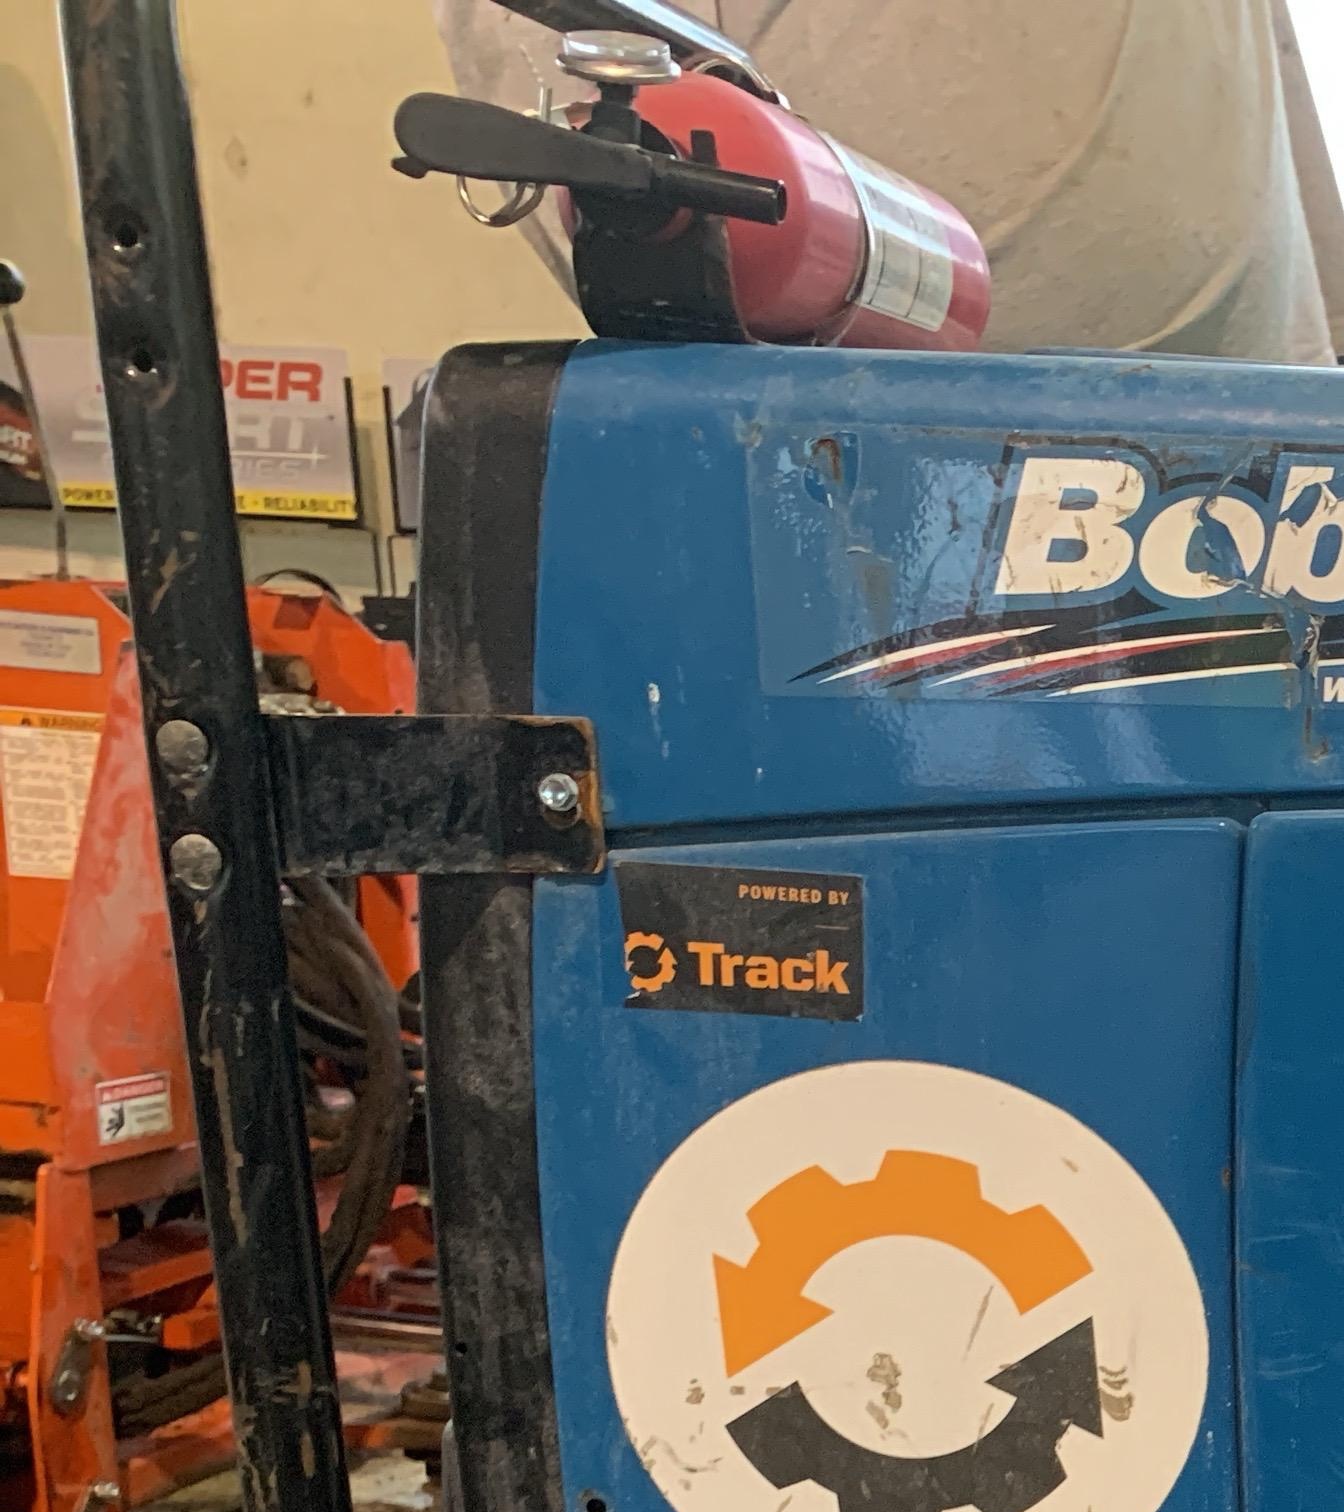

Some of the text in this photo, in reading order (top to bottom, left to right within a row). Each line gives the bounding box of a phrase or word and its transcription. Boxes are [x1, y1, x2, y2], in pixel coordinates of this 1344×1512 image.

[738, 884, 849, 906] POWERED BY
[687, 941, 850, 995] Track
